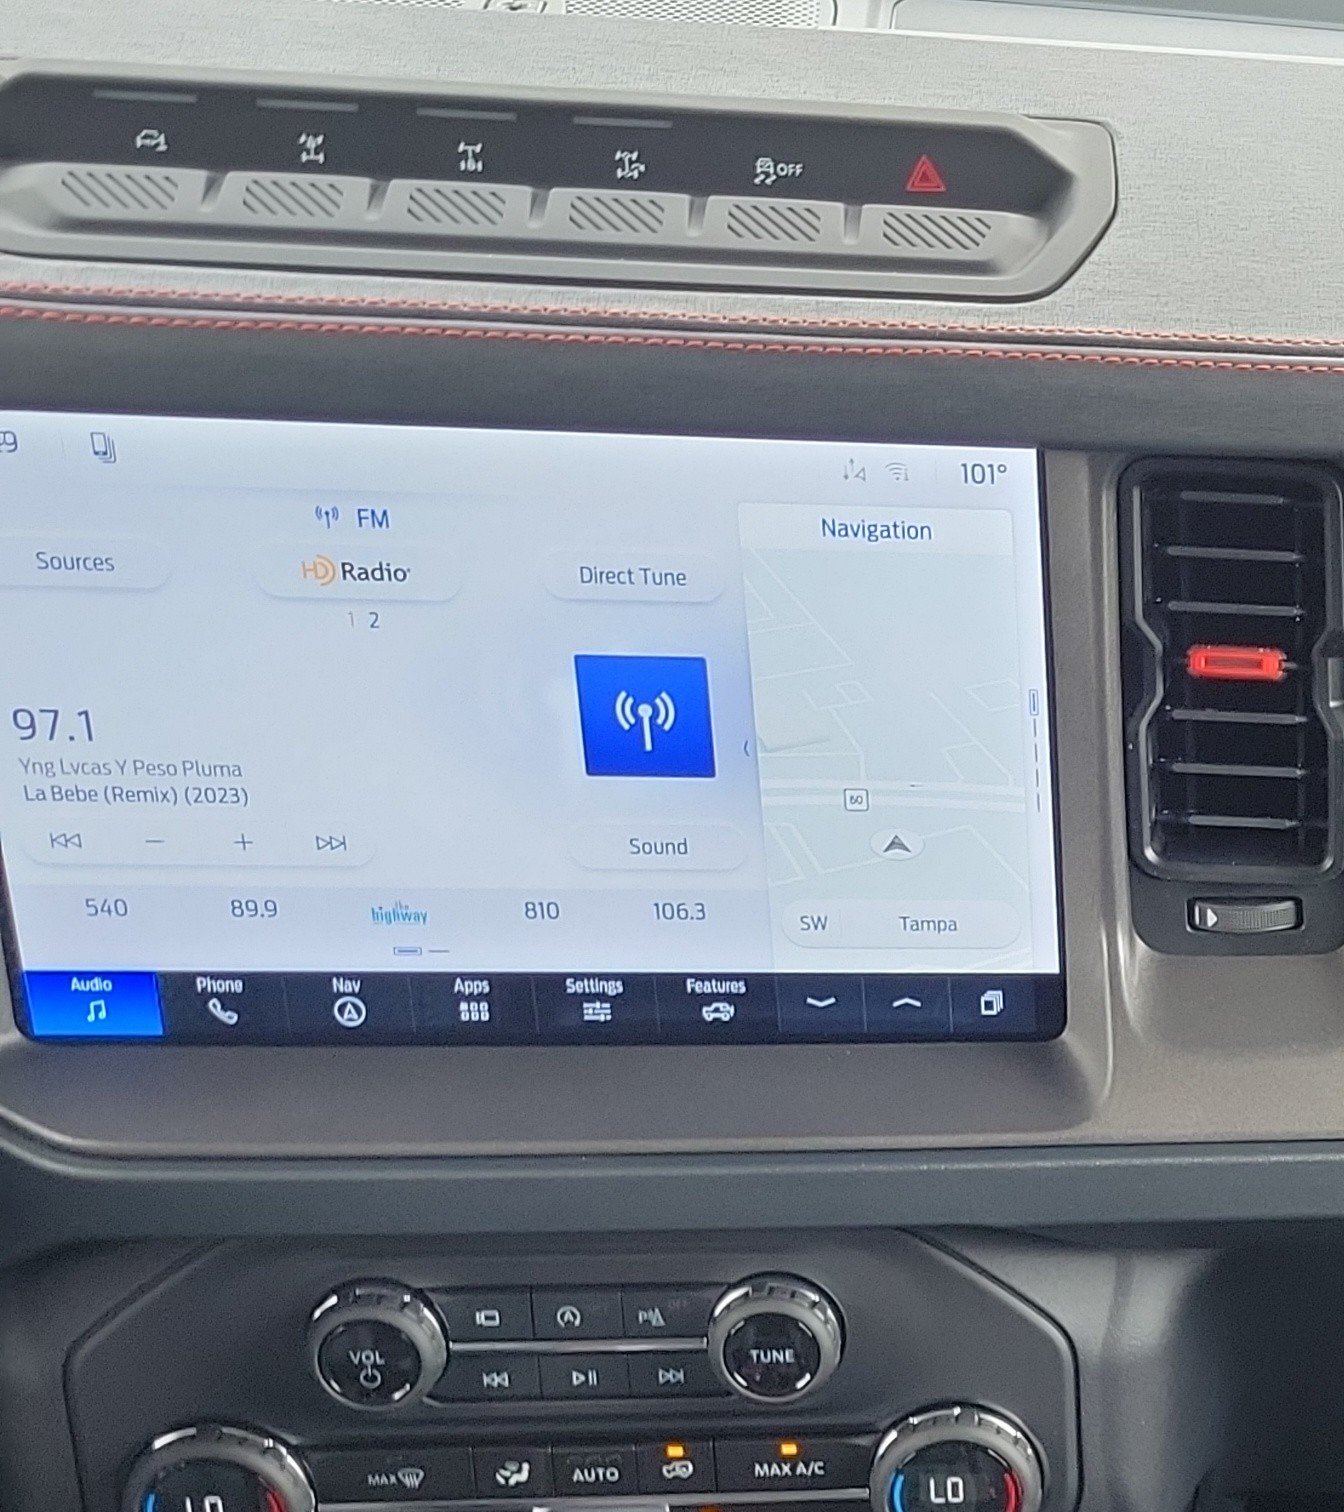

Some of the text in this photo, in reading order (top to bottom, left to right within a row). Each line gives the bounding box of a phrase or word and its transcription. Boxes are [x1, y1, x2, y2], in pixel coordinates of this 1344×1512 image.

[776, 163, 804, 177] OFF
[960, 462, 1008, 486] 101°
[356, 508, 390, 529] FM
[821, 517, 933, 543] Navigation
[35, 552, 115, 573] Sources
[341, 560, 408, 583] Radio
[579, 565, 687, 587] Direct Tune
[369, 611, 380, 629] 2
[12, 708, 94, 742] 97.1
[18, 757, 243, 778] Yng Lvcas Y Peso Pluma
[24, 785, 249, 807] La Bebe (Remix) (2023)
[629, 836, 689, 857] Sound
[85, 898, 129, 918] 540
[230, 898, 279, 919] 89.9
[371, 906, 428, 926] highway
[524, 901, 561, 921] 810
[653, 901, 707, 921] 106.3
[799, 913, 829, 933] SW
[900, 914, 958, 936] Tampa
[70, 975, 113, 994] Audio
[196, 975, 243, 994] Phone
[333, 976, 361, 994] Nav
[454, 976, 490, 998] Apps
[565, 976, 624, 998] Settings
[686, 976, 746, 995] Features
[350, 1350, 385, 1367] VOL
[750, 1348, 795, 1364] TUNE
[573, 1467, 620, 1484] AUTO
[754, 1460, 825, 1478] MAX A/C
[368, 1474, 397, 1487] MAX
[930, 1476, 964, 1505] LO
